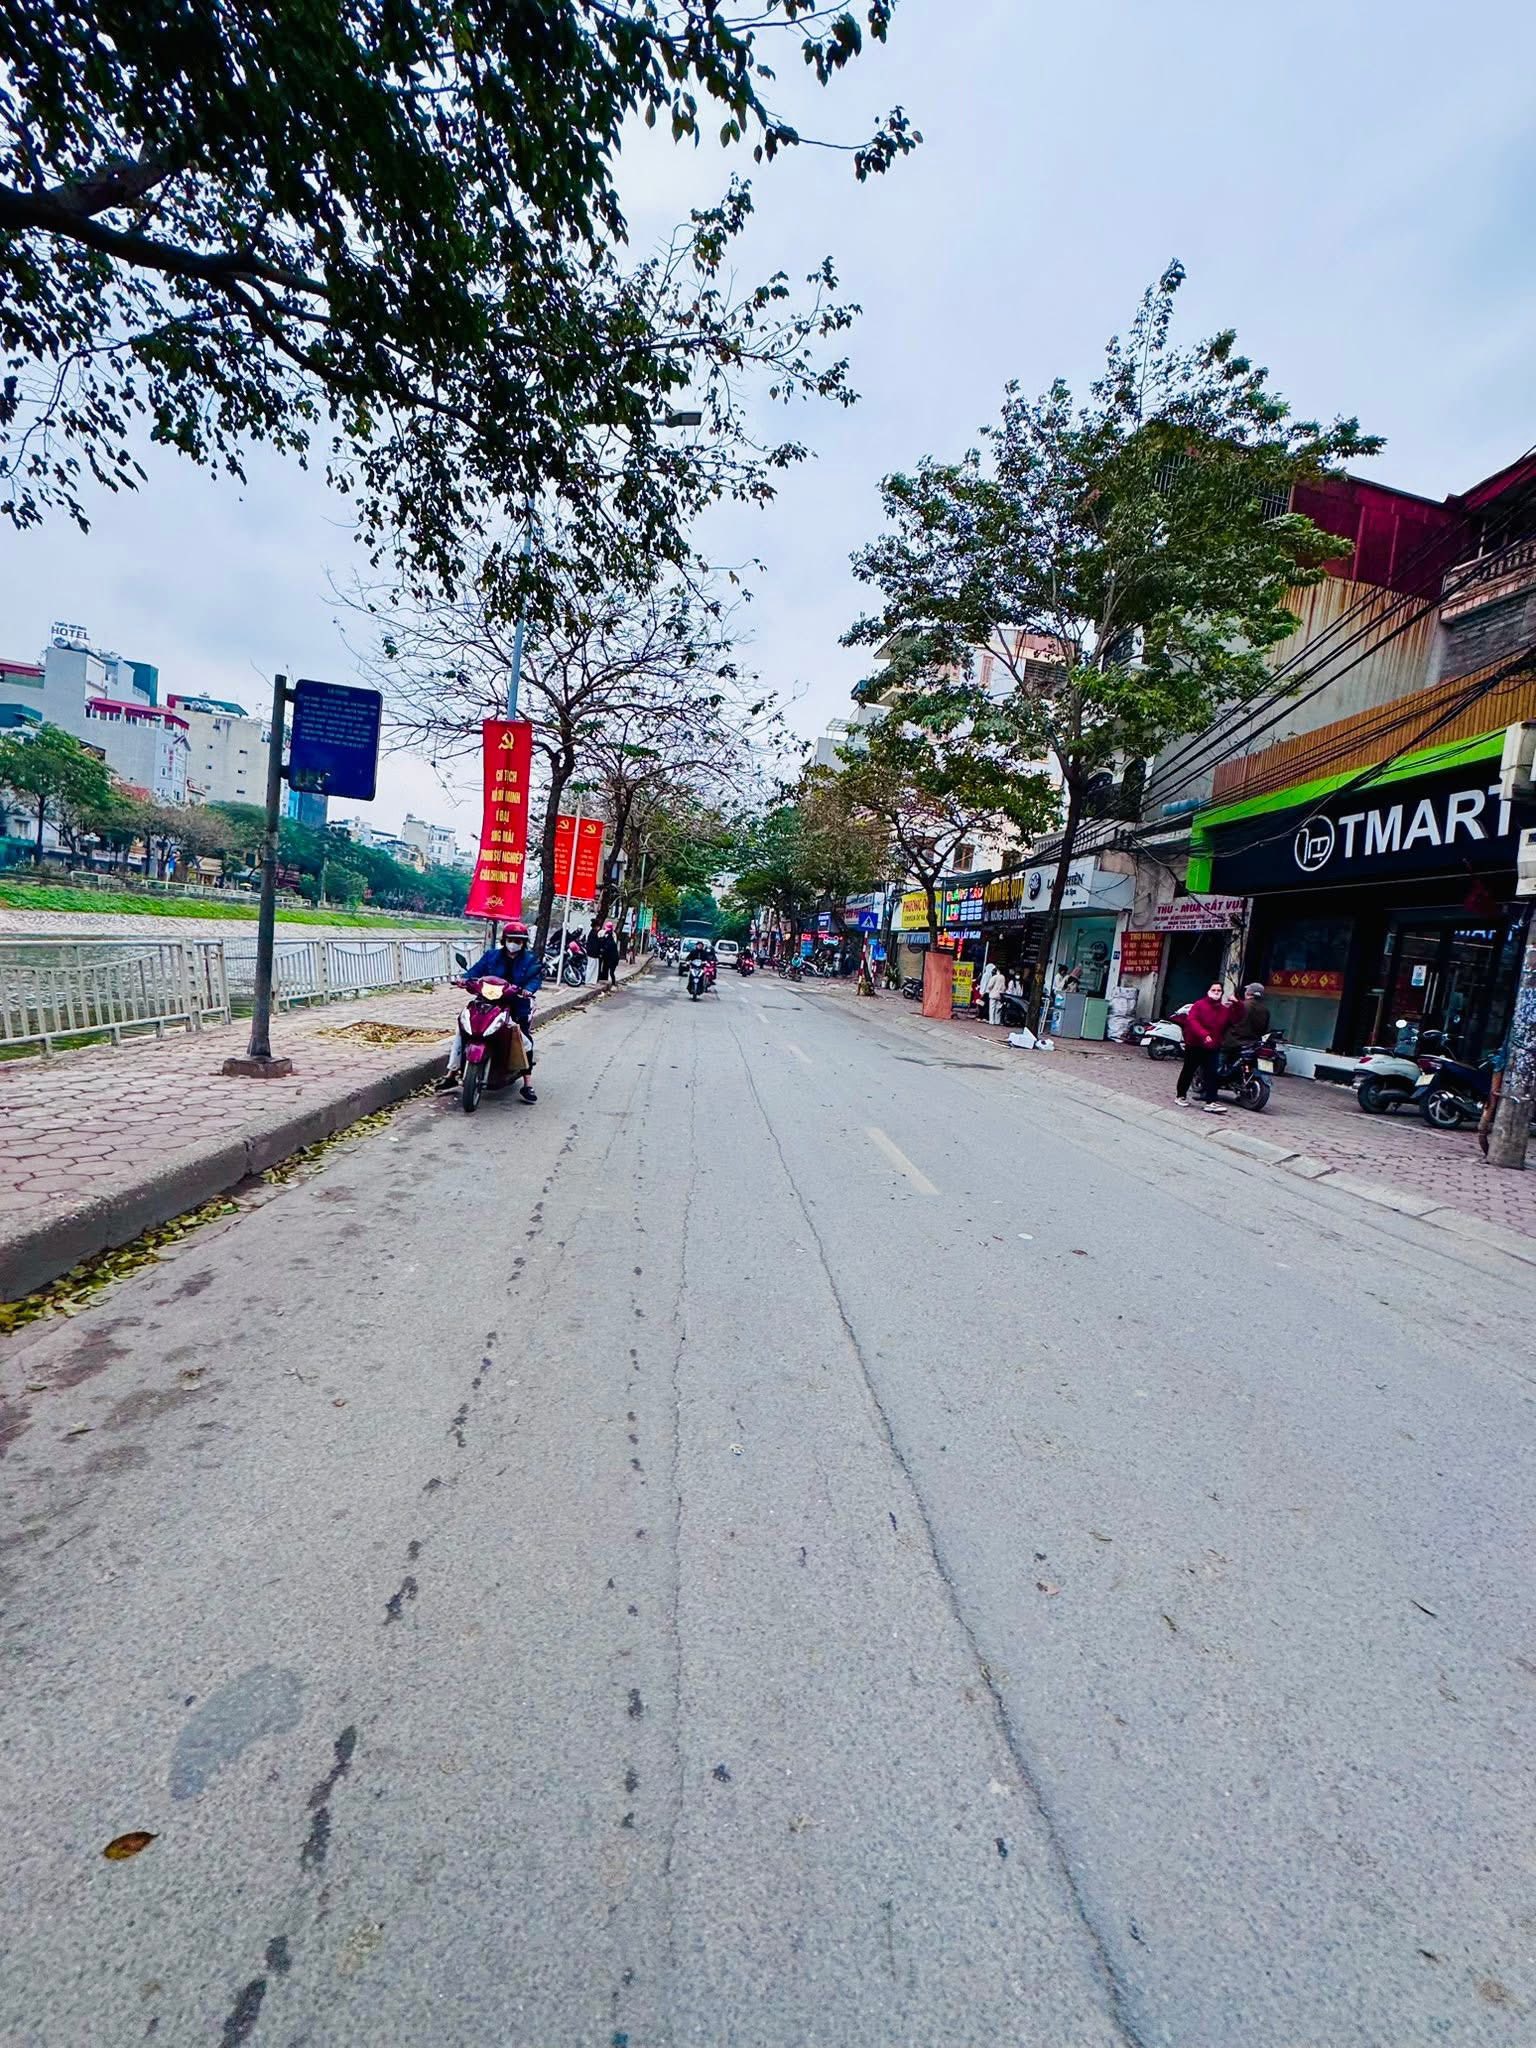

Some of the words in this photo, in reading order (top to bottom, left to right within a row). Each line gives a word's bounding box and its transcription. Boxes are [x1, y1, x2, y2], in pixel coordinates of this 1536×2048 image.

[51, 626, 90, 640] HOTEL
[1338, 784, 1511, 858] TMART
[1157, 904, 1174, 914] THU
